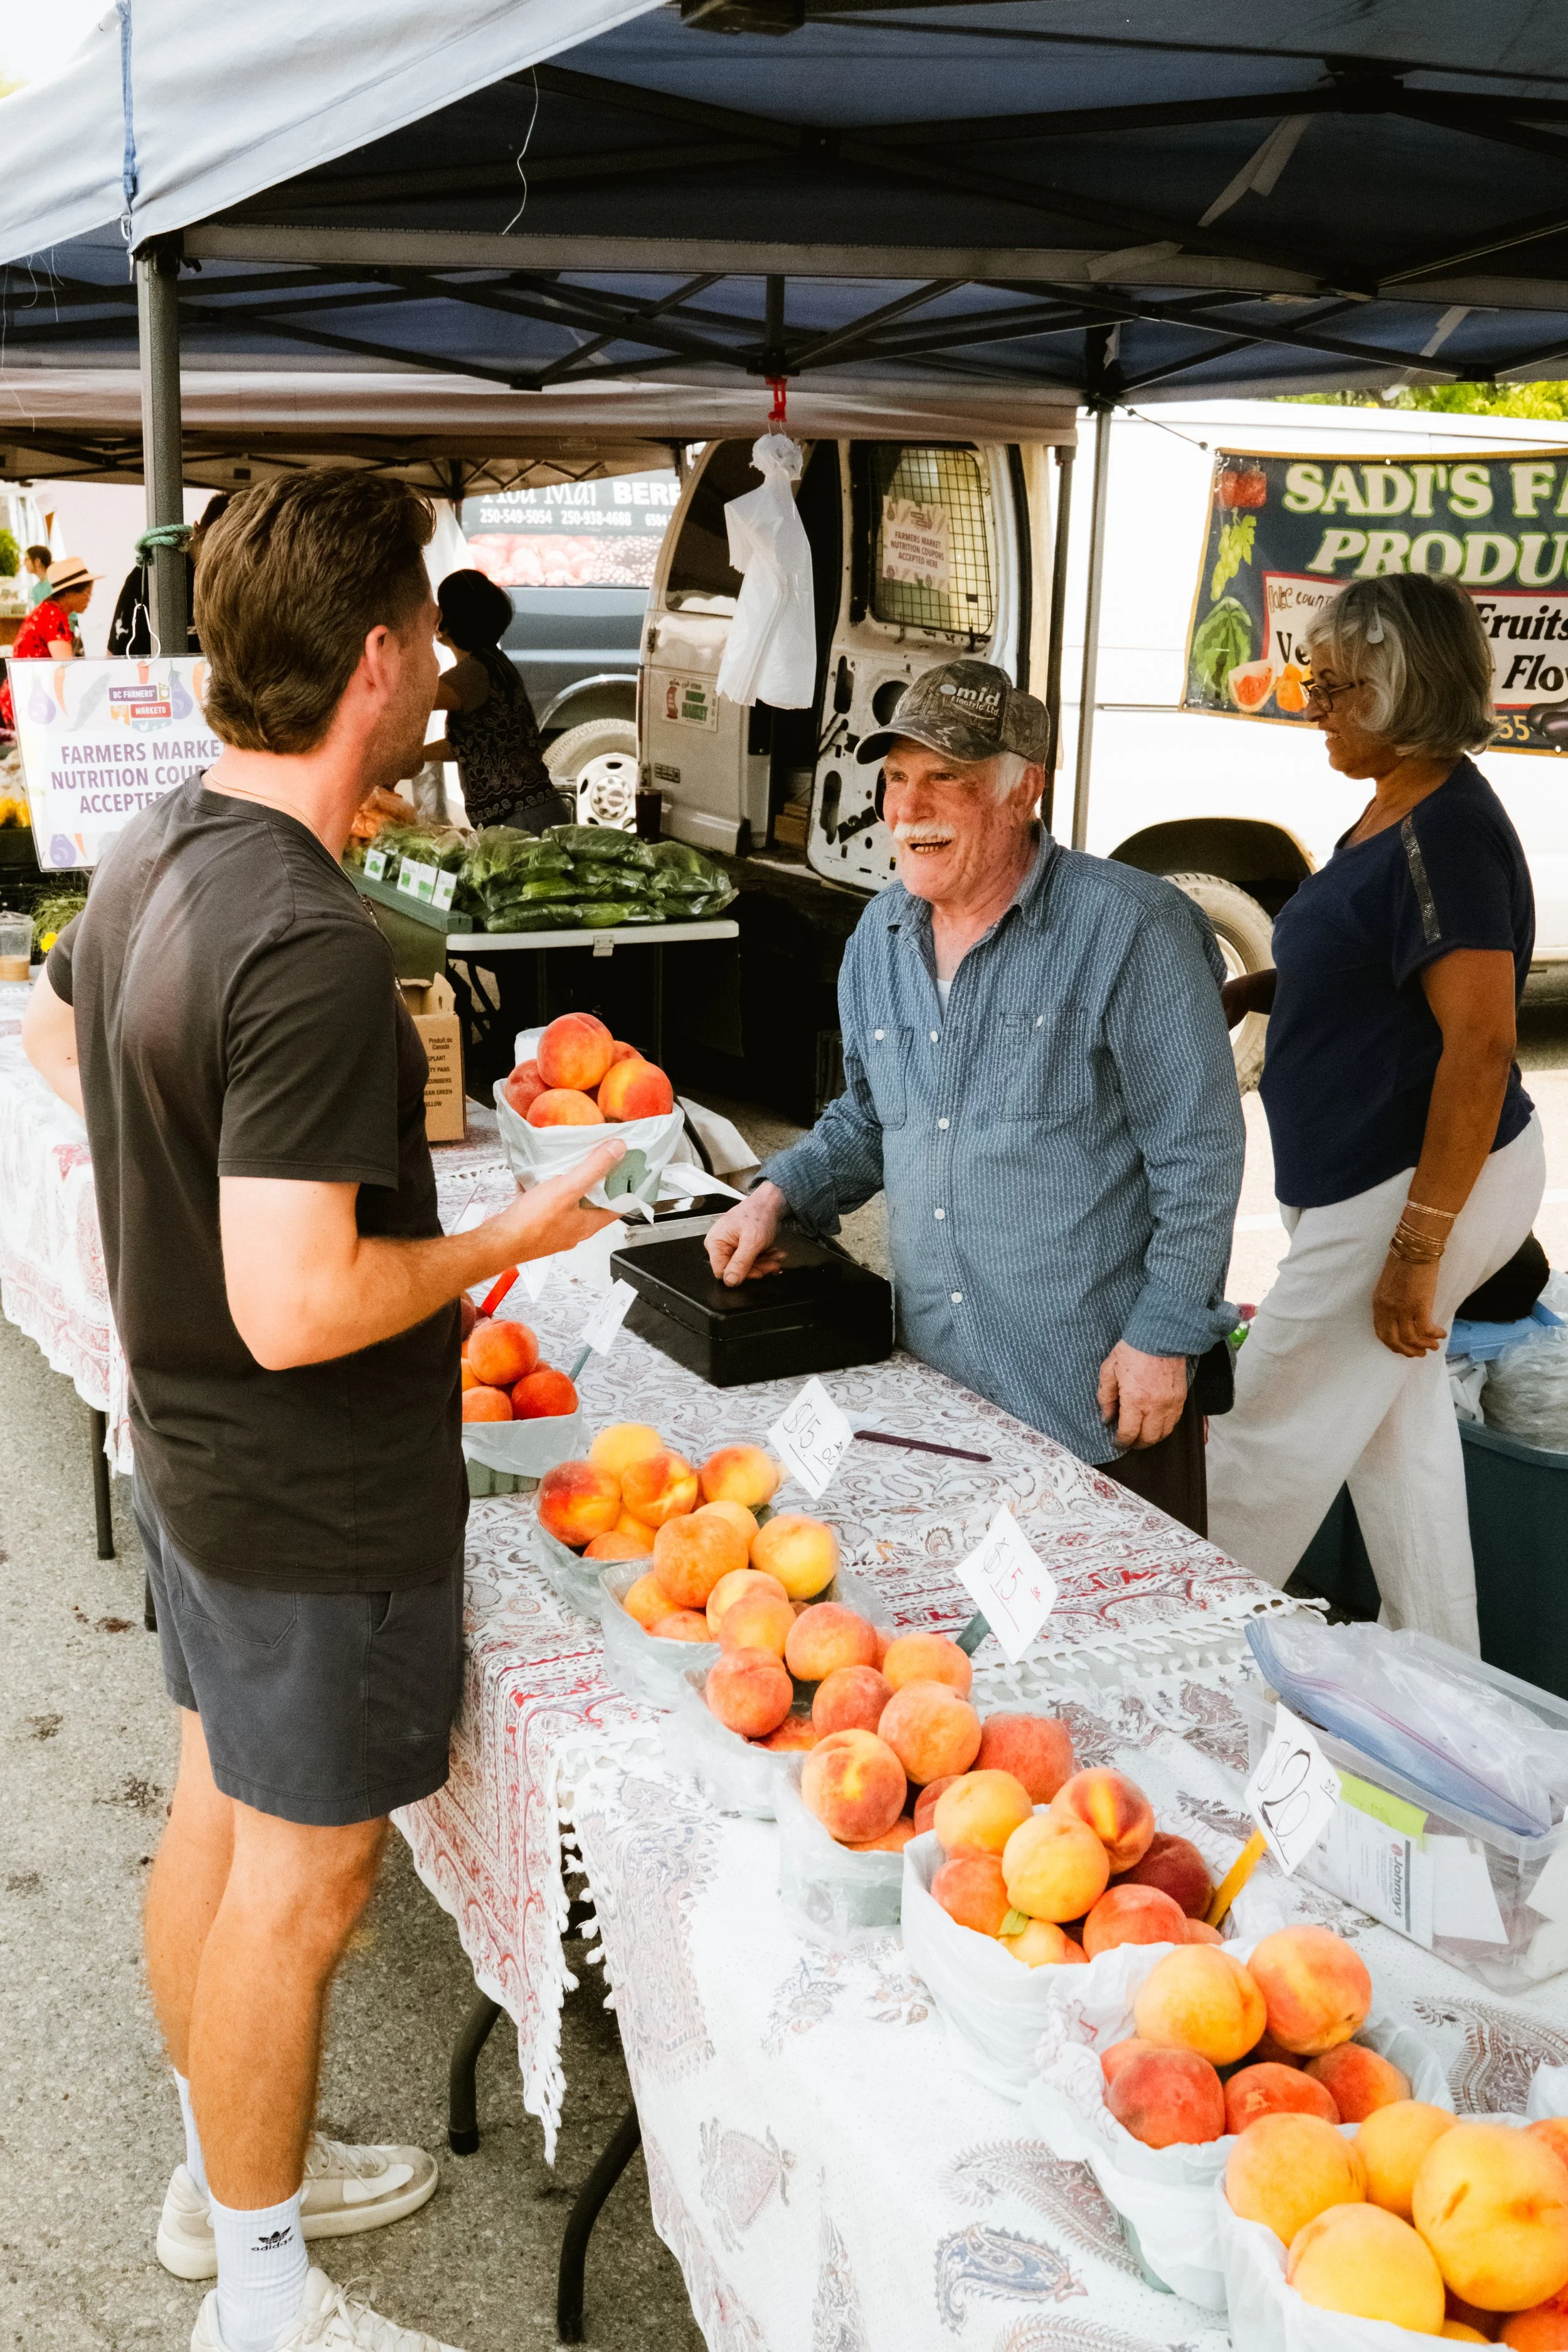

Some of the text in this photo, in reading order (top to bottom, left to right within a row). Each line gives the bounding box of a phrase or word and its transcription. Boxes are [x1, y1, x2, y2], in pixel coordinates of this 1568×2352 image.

[1283, 463, 1568, 518] SADI'S F
[480, 509, 553, 524] 250-549-5054
[895, 531, 941, 548] FARMERS MARKET
[891, 541, 944, 561] NUTRITION COUPONS
[898, 552, 938, 569] ACCEPTED HERE
[1306, 529, 1568, 586] PRODU
[1502, 654, 1568, 692] Flo
[123, 689, 155, 699] FARMERS'
[135, 706, 166, 715] MARKETS
[61, 739, 225, 764] FARMERS MARKE
[51, 768, 149, 790] NUTRITION
[80, 792, 164, 813] ACCEPTE
[1392, 1857, 1403, 1918] Johnny's
[252, 2234, 295, 2252] adidas
